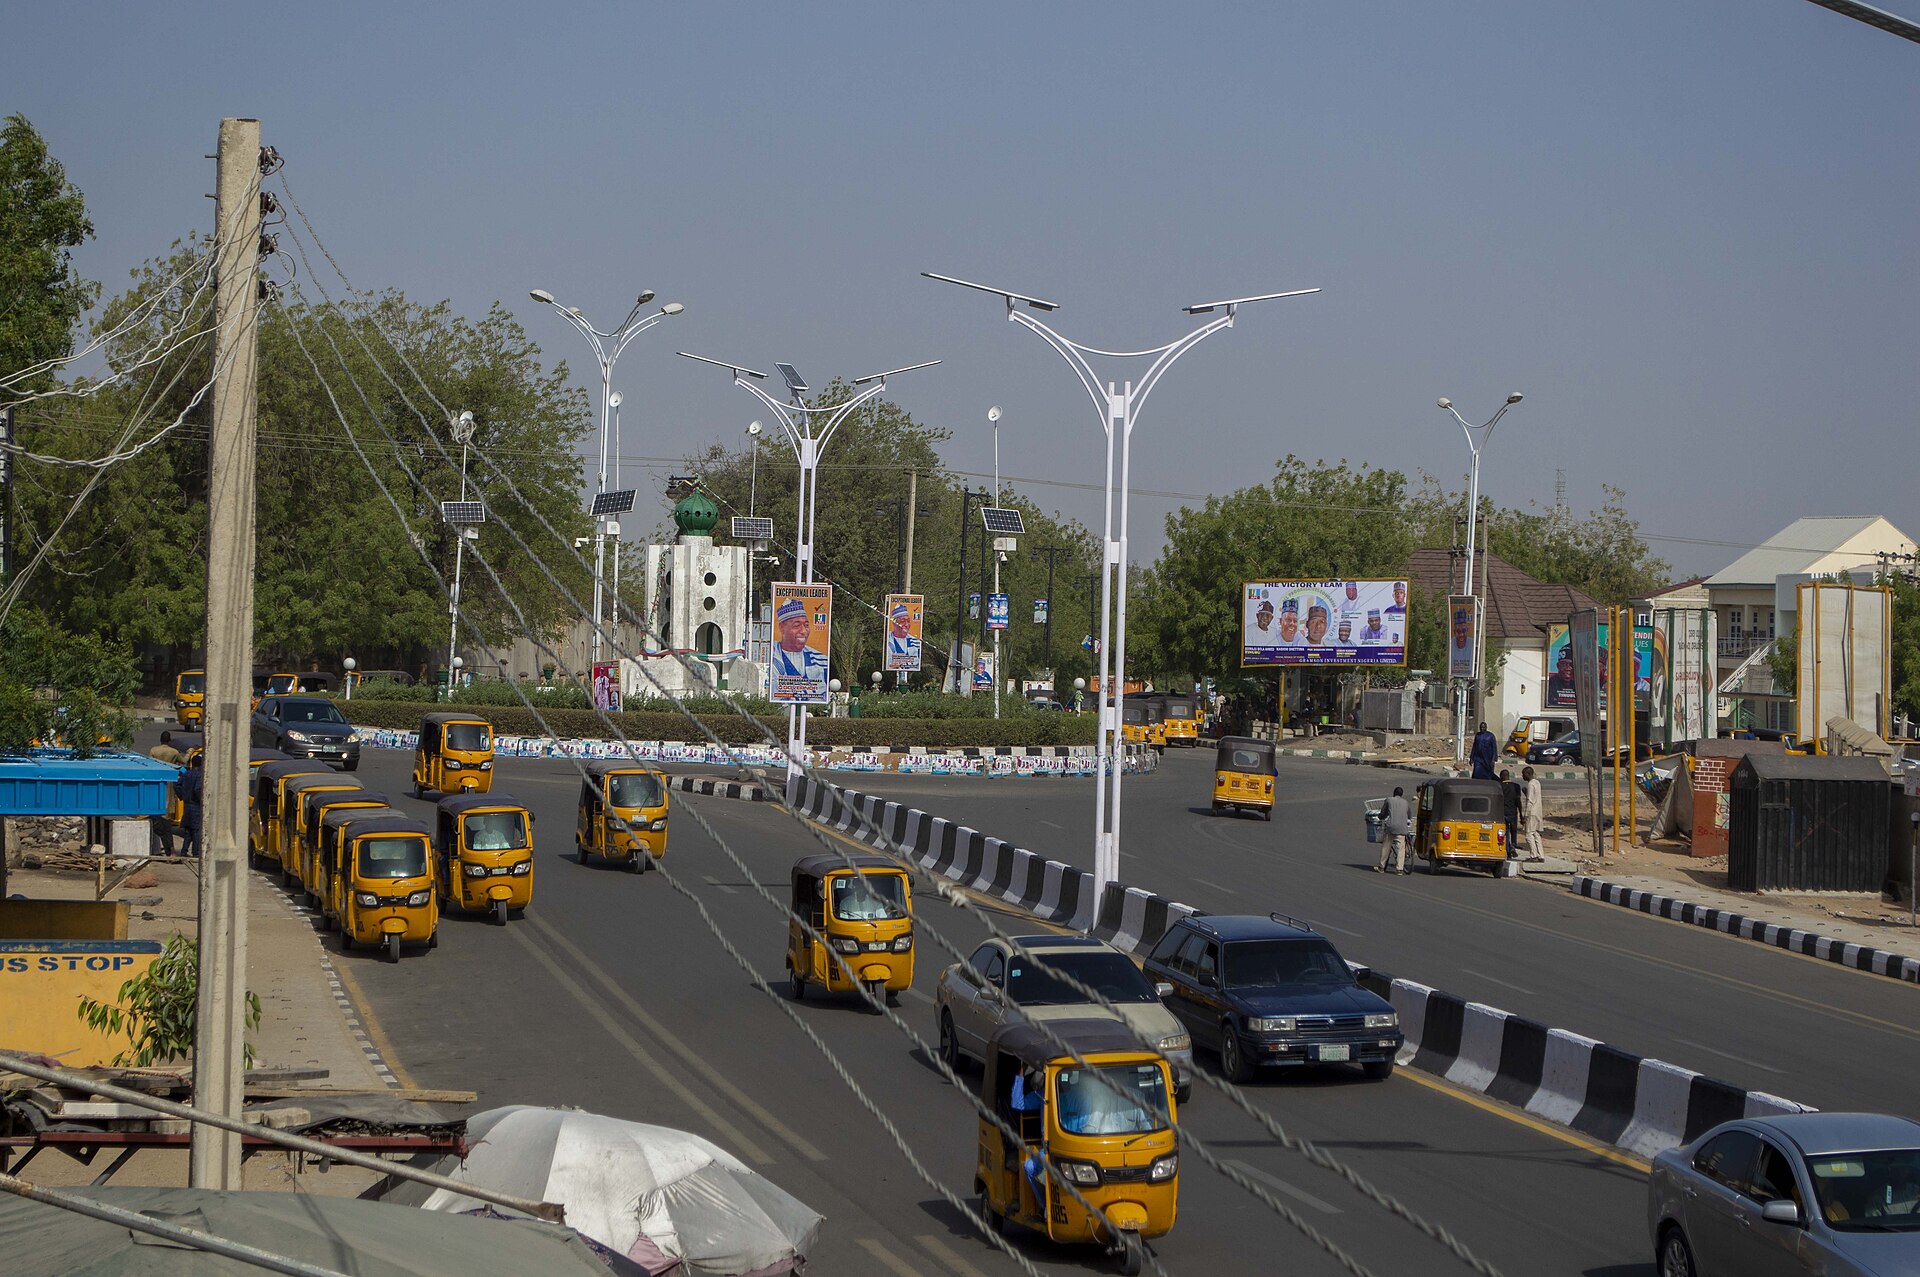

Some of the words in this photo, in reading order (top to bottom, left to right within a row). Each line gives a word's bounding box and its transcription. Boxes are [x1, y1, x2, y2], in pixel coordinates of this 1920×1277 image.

[776, 588, 809, 597] EXCEPTIONAL
[810, 588, 828, 598] LEADER
[0, 957, 29, 973] S
[38, 956, 134, 971] STOP
